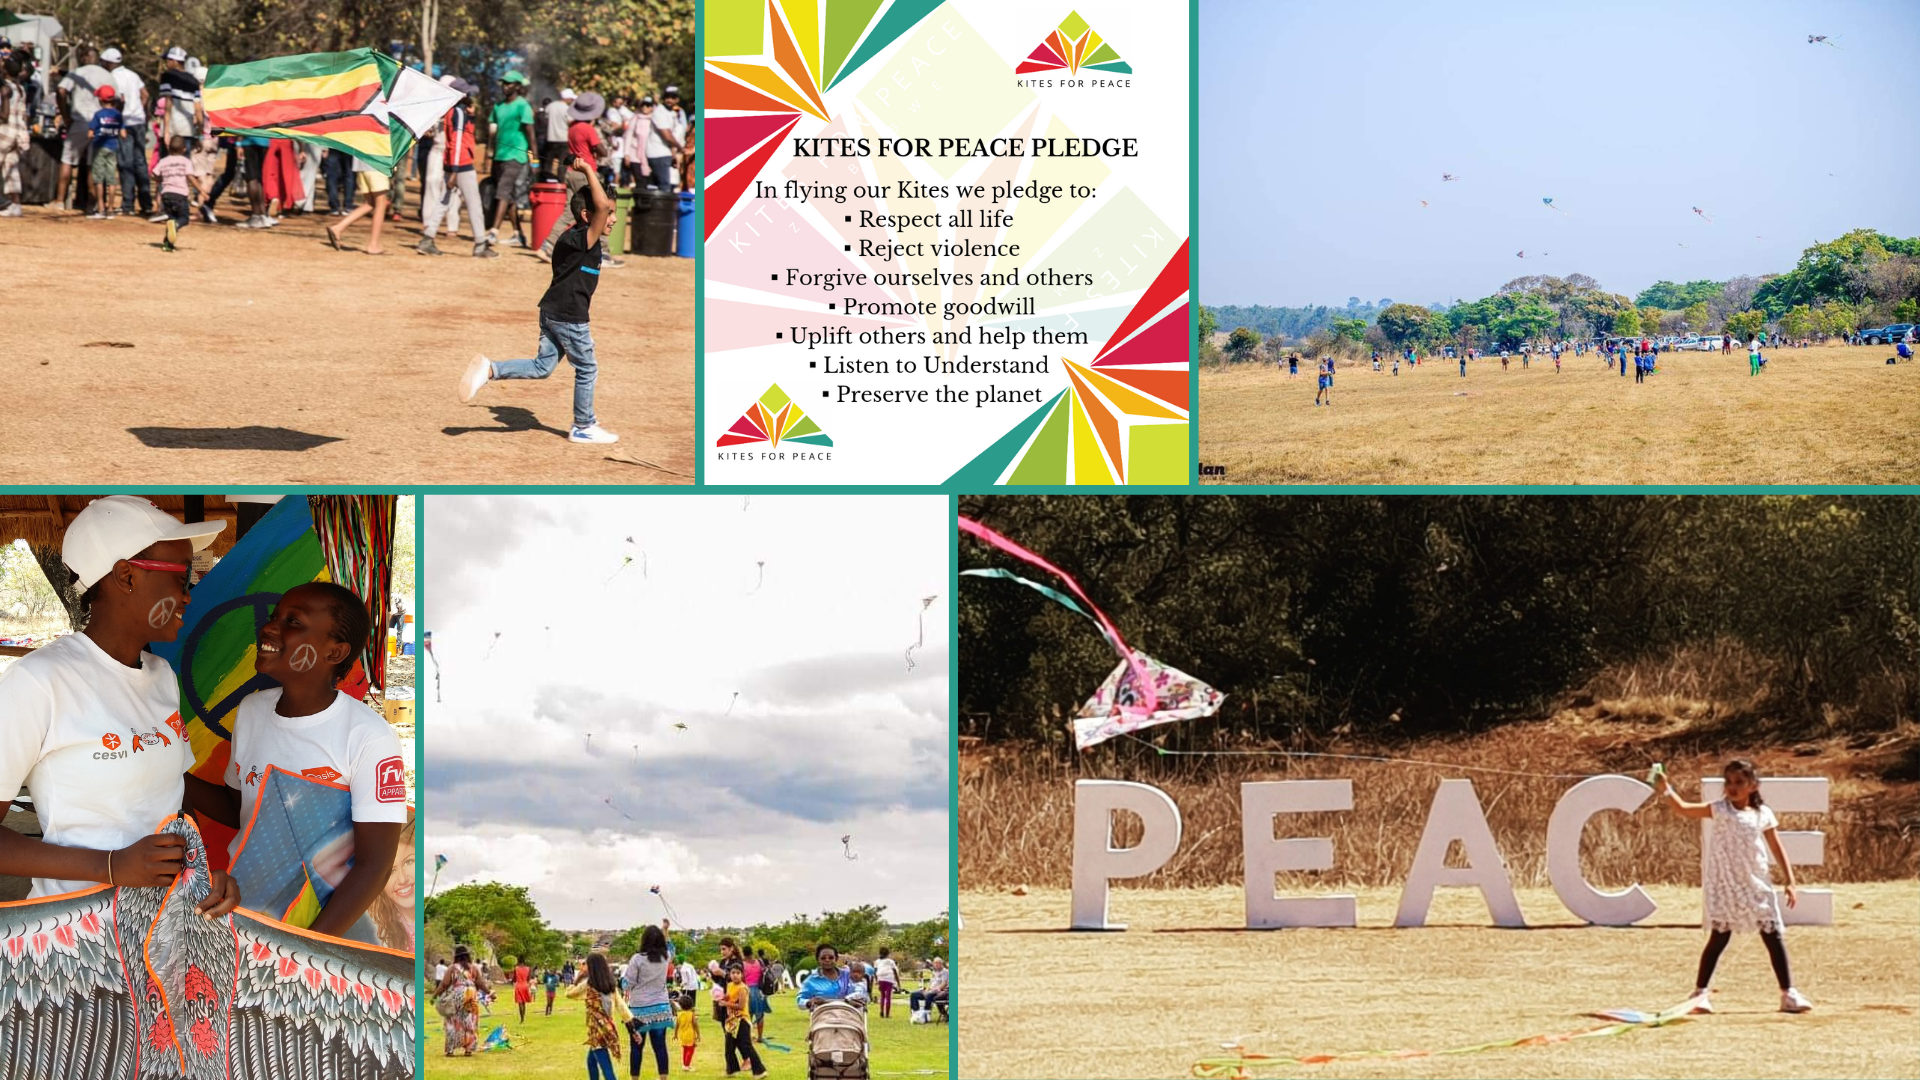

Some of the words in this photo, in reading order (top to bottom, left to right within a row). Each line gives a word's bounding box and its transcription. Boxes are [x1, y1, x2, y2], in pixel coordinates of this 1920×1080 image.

[875, 20, 962, 107] PEACE
[1017, 79, 1054, 88] KITES
[1060, 79, 1084, 88] FOR
[1091, 79, 1131, 88] PEACE
[793, 137, 871, 158] KITES
[877, 137, 933, 158] FOR
[938, 137, 1025, 158] PEACE
[1031, 137, 1139, 158] PLEDGE
[755, 180, 778, 199] In
[783, 179, 848, 204] flying
[853, 185, 892, 199] our
[897, 180, 949, 199] Kites
[955, 185, 985, 199] we
[991, 179, 1063, 204] pledge
[1069, 183, 1097, 199] to:
[859, 209, 943, 233] Respect
[948, 209, 974, 228] all
[979, 209, 1014, 228] life
[858, 238, 925, 262] Reject
[930, 238, 1020, 257] violence
[785, 268, 867, 291] Forgive
[873, 267, 974, 286] ourselves
[980, 267, 1020, 286] and
[1026, 267, 1094, 286] others
[843, 297, 937, 315] Promote
[943, 296, 1035, 321] goodwill
[790, 325, 853, 350] Uplift
[859, 325, 926, 345] others
[932, 325, 972, 345] and
[978, 325, 1026, 350] help
[1032, 325, 1089, 345] them
[823, 355, 890, 374] Listen
[895, 358, 917, 374] to
[923, 354, 1050, 374] Understand
[836, 385, 929, 403] Preserve
[935, 384, 969, 403] the
[975, 384, 1043, 408] planet
[717, 452, 754, 461] KITES
[761, 452, 785, 461] FOR
[792, 452, 831, 461] PEACE
[92, 750, 128, 760] cesvi
[1070, 774, 1833, 932] PEACE
